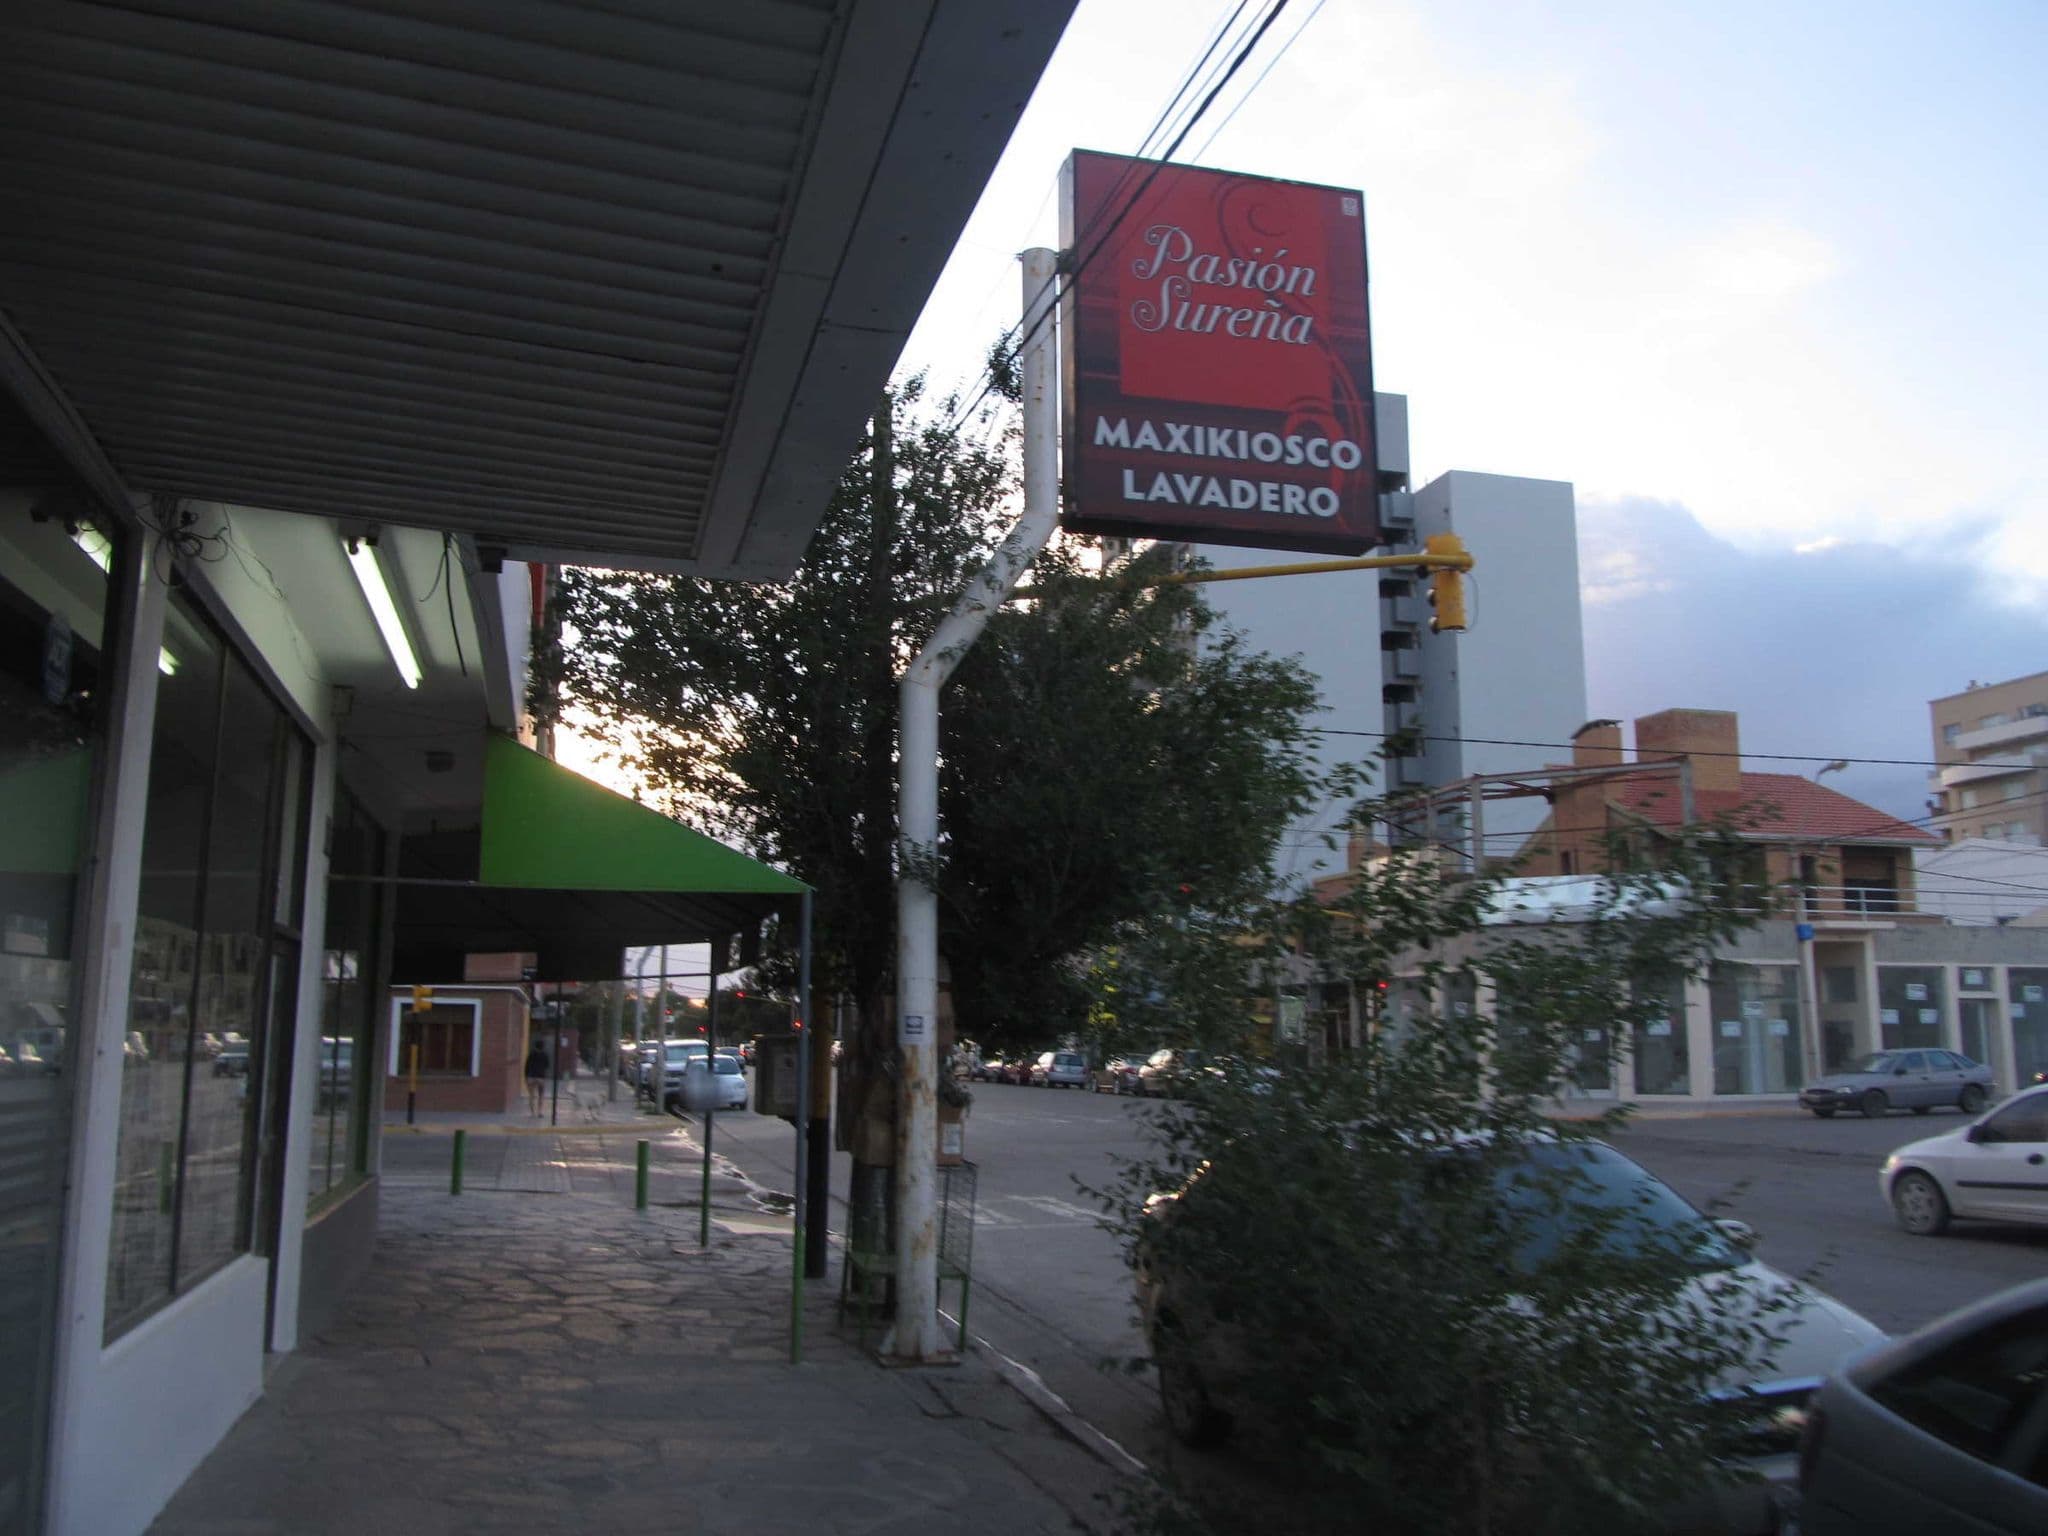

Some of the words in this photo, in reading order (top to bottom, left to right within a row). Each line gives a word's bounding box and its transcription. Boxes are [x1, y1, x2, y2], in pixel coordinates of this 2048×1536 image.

[1133, 225, 1316, 296] Pasión
[1132, 276, 1314, 345] Sureña
[1094, 415, 1362, 470] MAXIKIOSCO
[1123, 469, 1339, 517] LAVADERO
